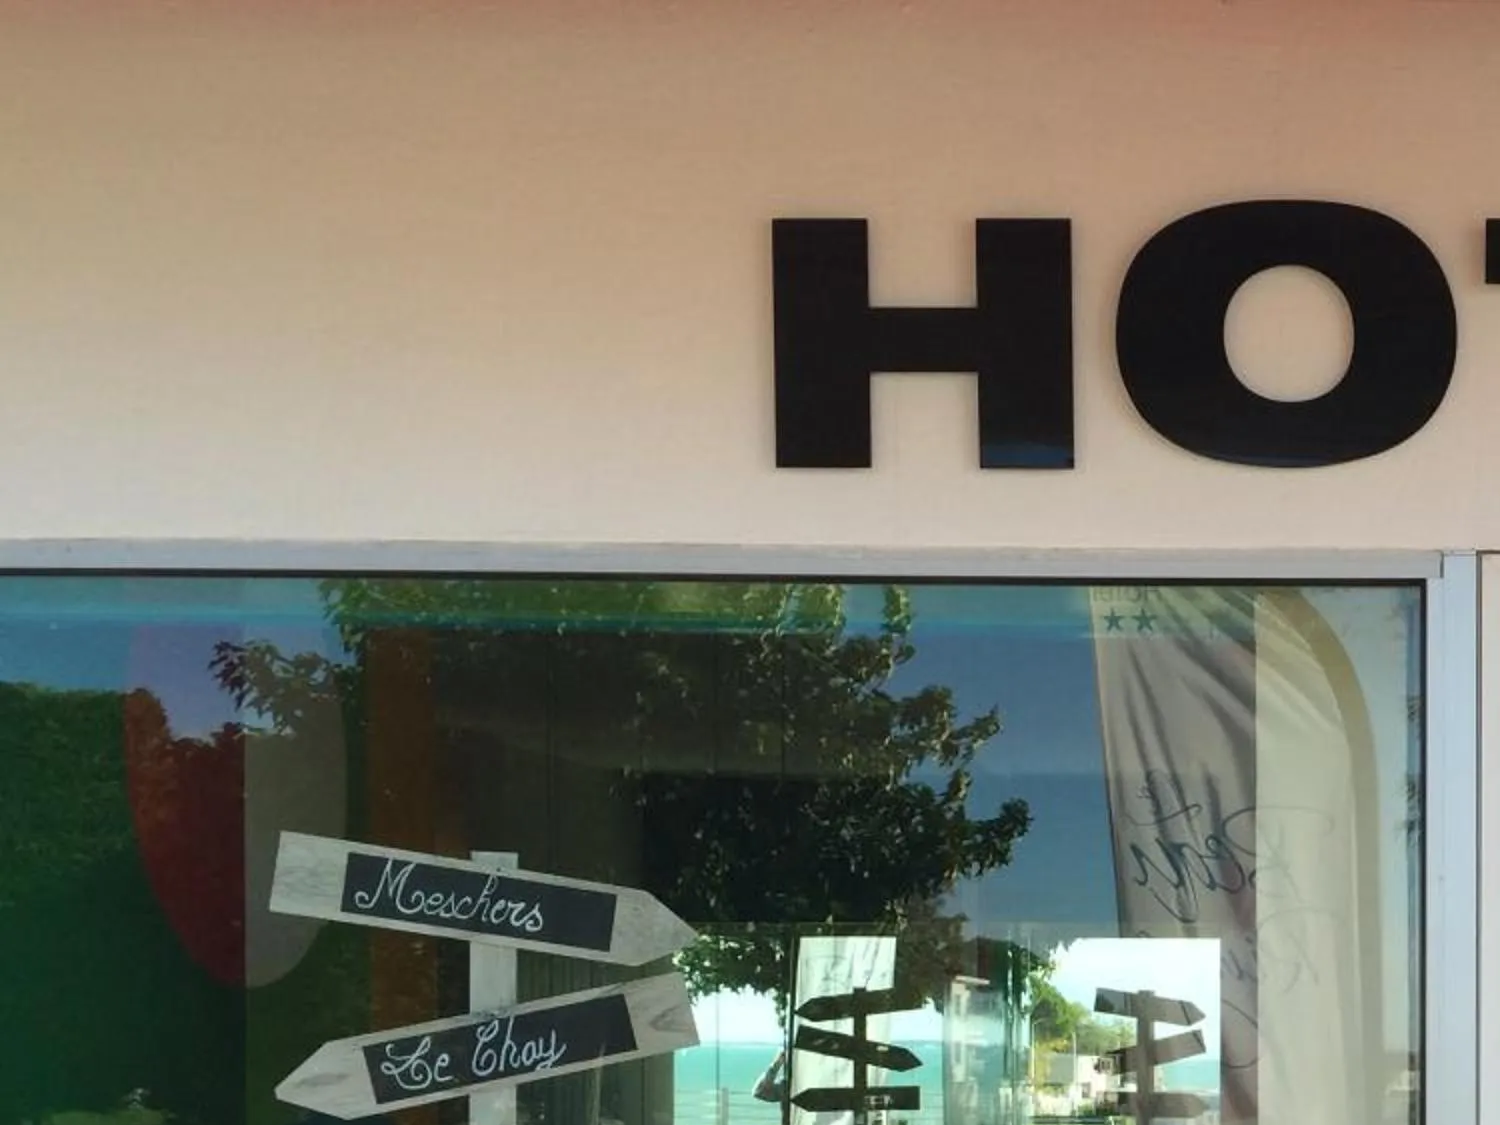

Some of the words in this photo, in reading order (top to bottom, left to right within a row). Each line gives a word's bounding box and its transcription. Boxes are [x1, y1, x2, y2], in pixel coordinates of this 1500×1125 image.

[355, 858, 544, 932] Meschers
[380, 1035, 454, 1090] Le
[471, 1015, 567, 1073] Chay
